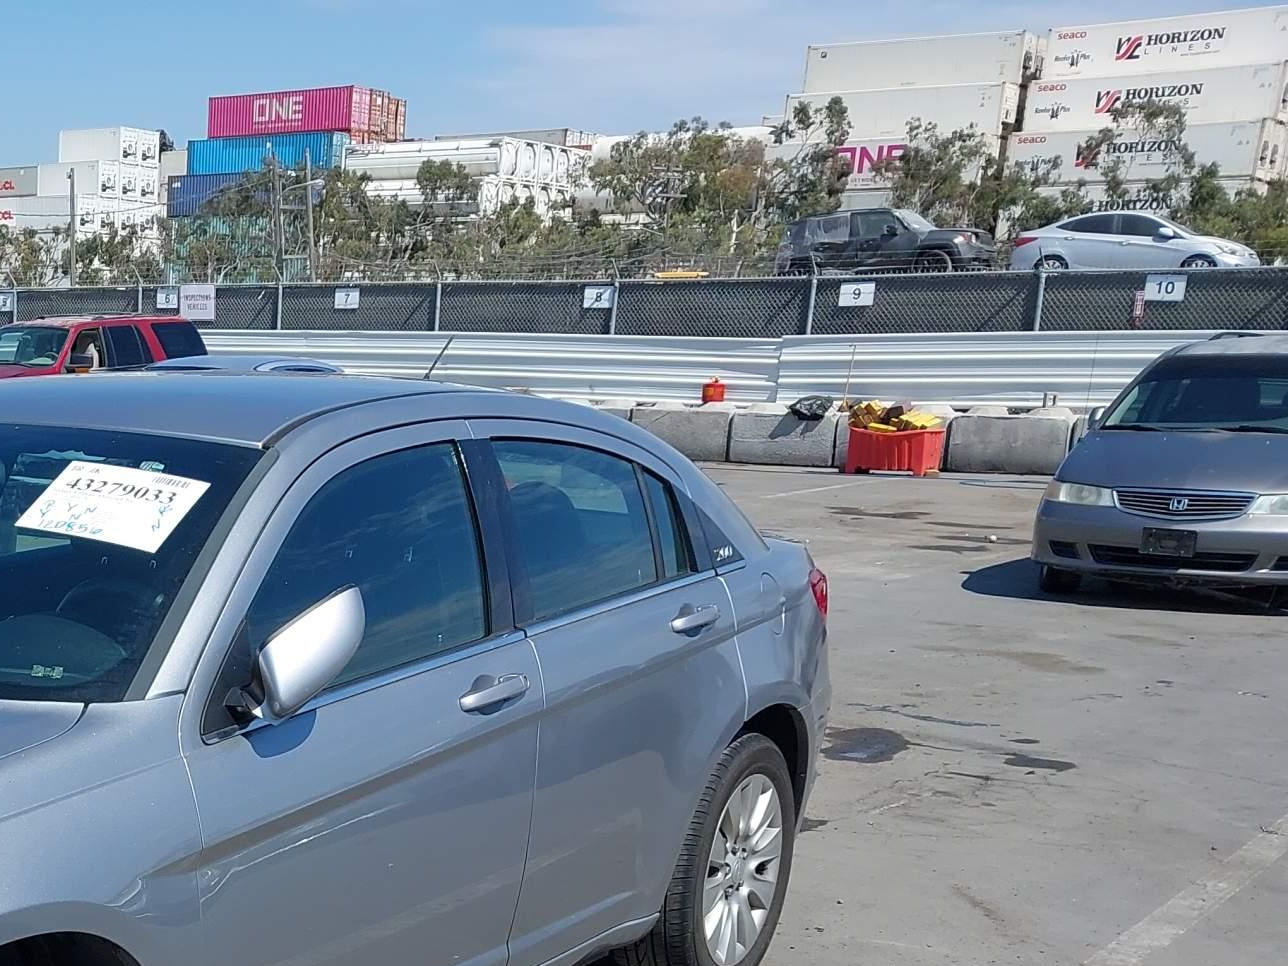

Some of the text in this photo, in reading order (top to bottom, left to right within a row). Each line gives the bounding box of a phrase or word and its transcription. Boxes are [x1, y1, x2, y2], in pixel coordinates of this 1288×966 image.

[1057, 31, 1087, 40] seaco
[1146, 27, 1226, 45] HORIZON
[1144, 42, 1211, 55] LINES
[1038, 84, 1067, 92] seaco
[1125, 83, 1204, 100] HORIZON
[253, 96, 303, 121] ONE
[1017, 136, 1046, 144] seaco
[1105, 139, 1180, 154] HORIZON
[853, 287, 862, 300] 9
[1156, 280, 1175, 295] 10
[344, 293, 351, 304] 7
[595, 291, 602, 303] 8
[66, 477, 177, 504] 43279033
